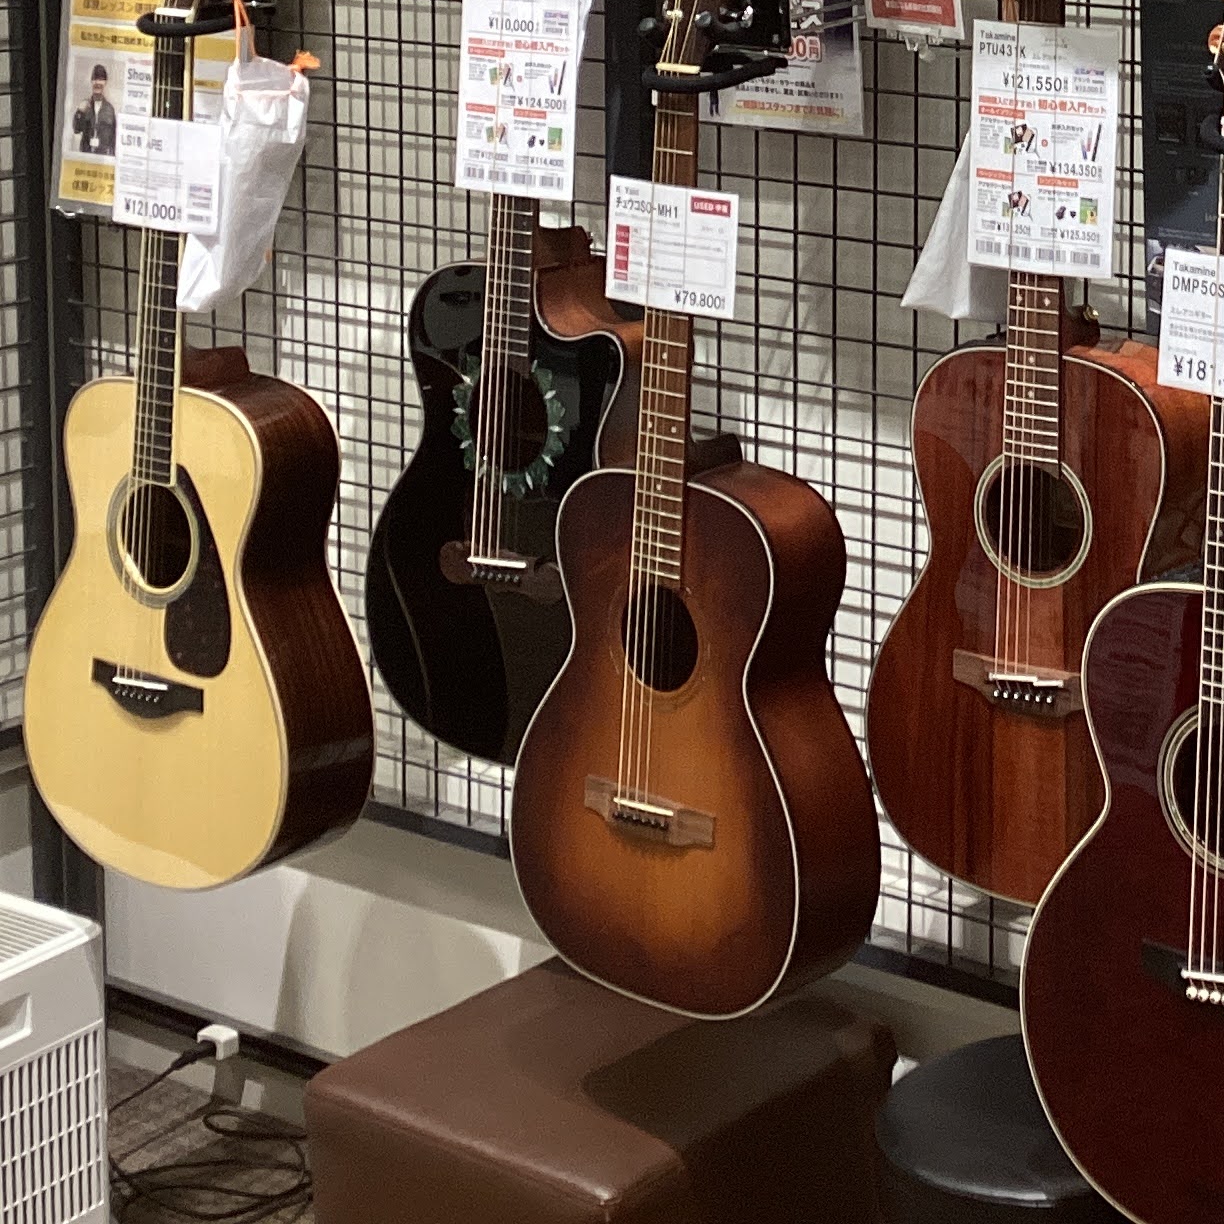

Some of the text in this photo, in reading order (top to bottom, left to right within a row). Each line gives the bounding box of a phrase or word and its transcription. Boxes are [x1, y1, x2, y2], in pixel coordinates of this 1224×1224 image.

[488, 17, 534, 33] ¥110,000
[980, 29, 1016, 42] Takamine
[1002, 72, 1063, 93] ¥121,550
[1049, 161, 1098, 178] ¥134,350
[1173, 261, 1216, 277] Takamine
